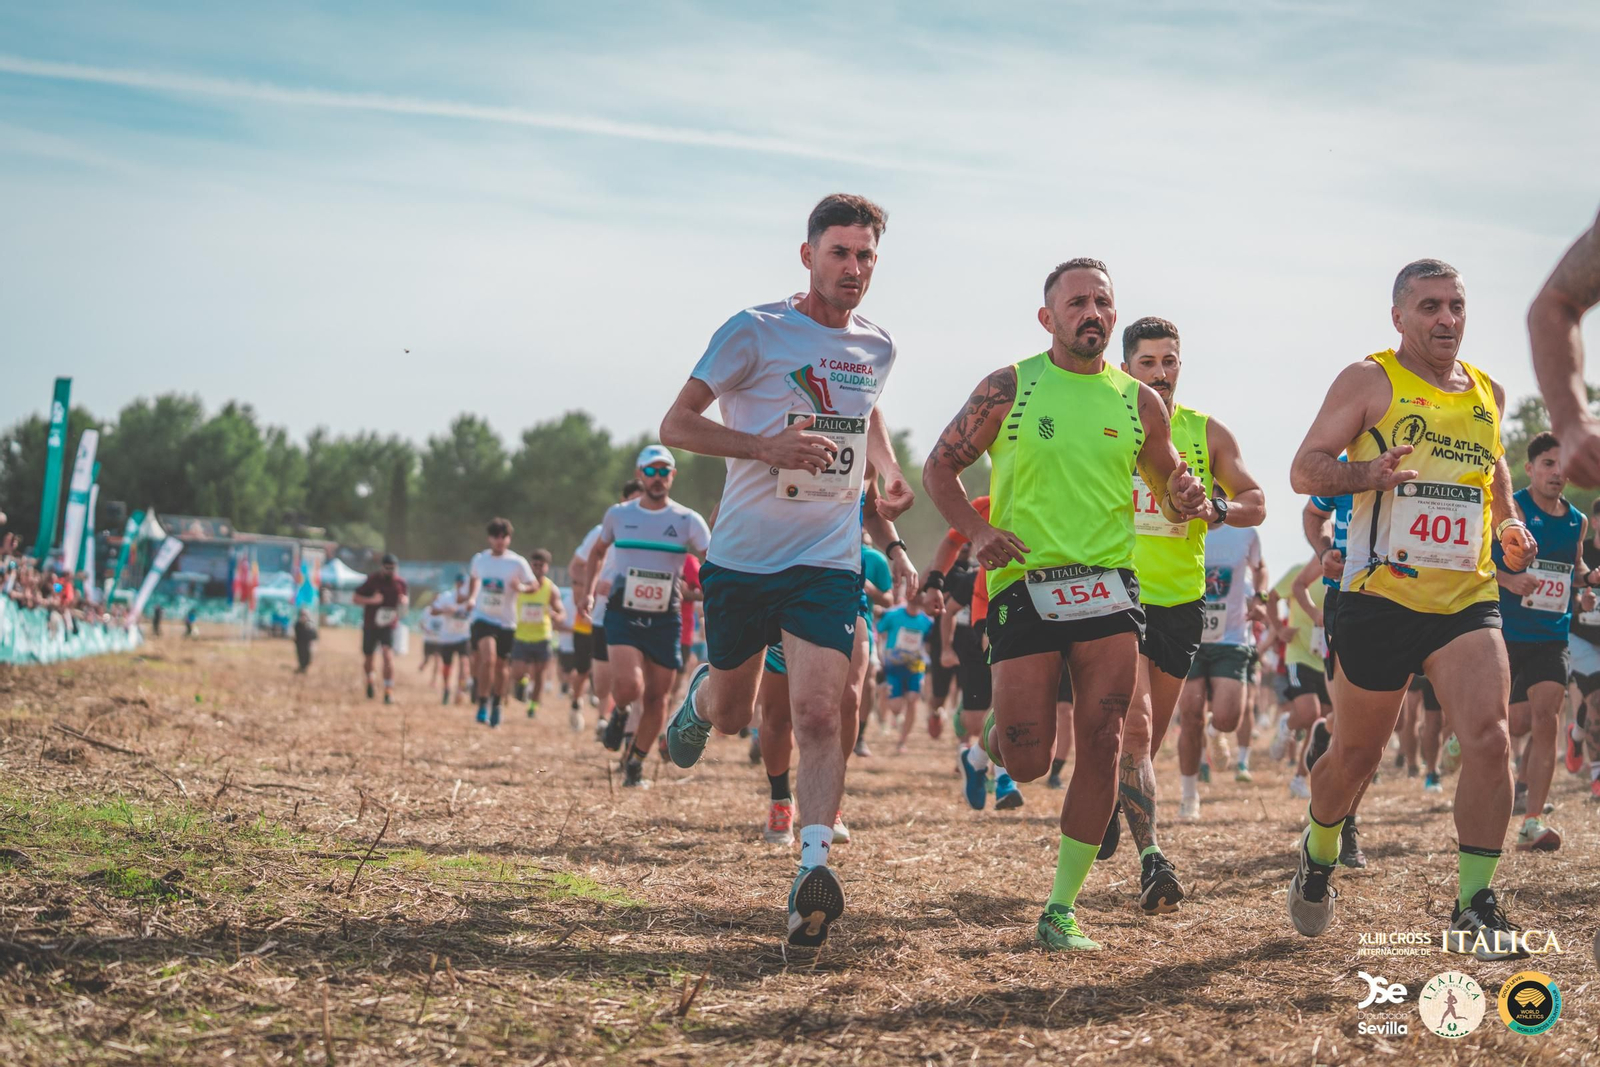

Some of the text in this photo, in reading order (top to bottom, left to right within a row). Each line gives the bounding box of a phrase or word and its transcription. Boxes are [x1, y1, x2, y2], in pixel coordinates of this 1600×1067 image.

[819, 357, 873, 375] X CARRERA
[830, 371, 877, 388] SOLIDARIA
[1425, 431, 1451, 446] CLUB
[1422, 484, 1465, 499] ITÁLICA
[1409, 513, 1469, 546] 401
[1051, 564, 1093, 579] ITÁLICA
[634, 584, 663, 600] 603
[1051, 581, 1111, 606] 154
[1535, 579, 1565, 598] 729
